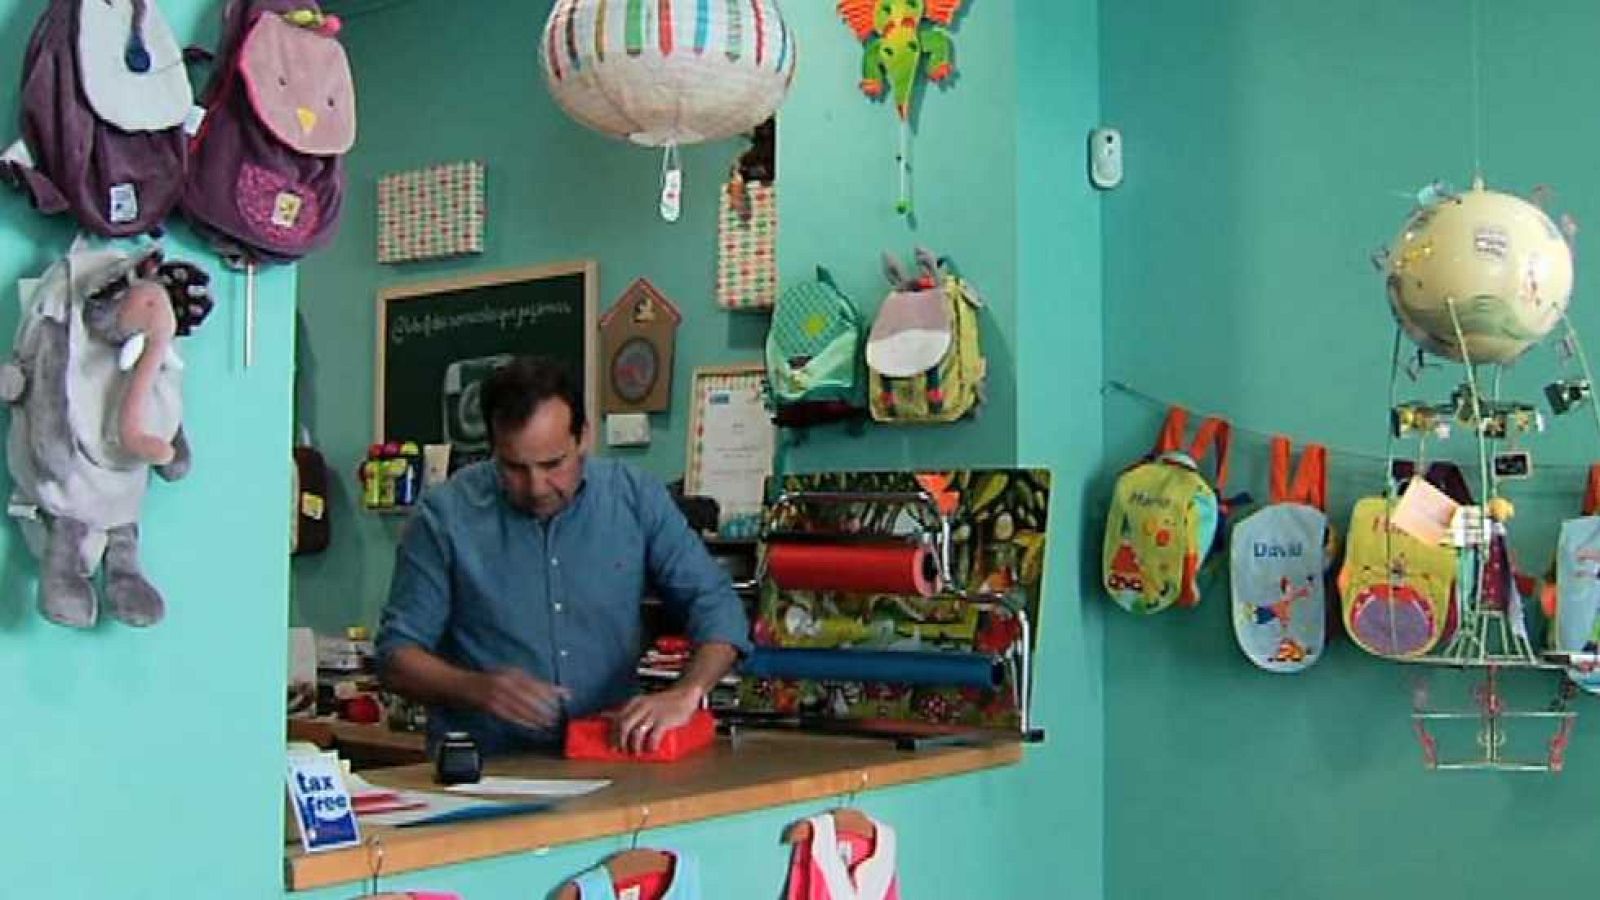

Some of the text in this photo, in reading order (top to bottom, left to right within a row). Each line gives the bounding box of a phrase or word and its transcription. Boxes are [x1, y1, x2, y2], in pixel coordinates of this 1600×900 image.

[1253, 542, 1304, 558] David
[297, 771, 336, 794] tax
[304, 794, 348, 828] free
